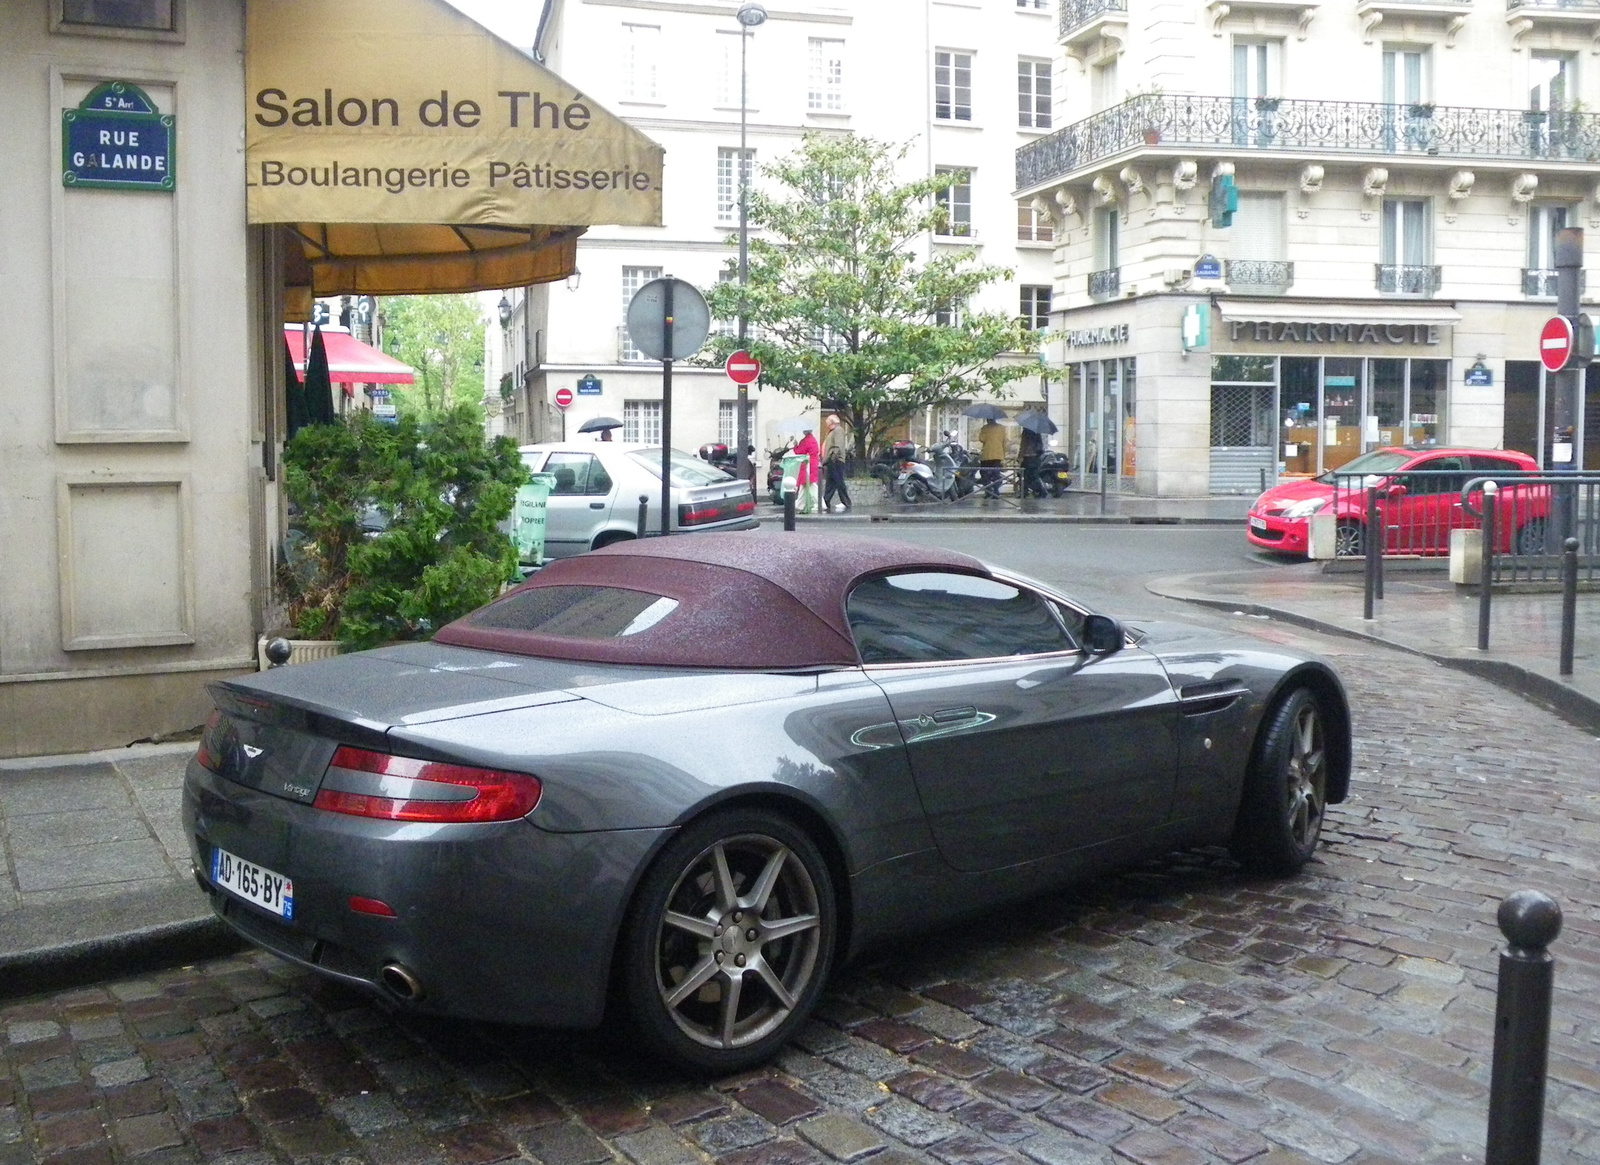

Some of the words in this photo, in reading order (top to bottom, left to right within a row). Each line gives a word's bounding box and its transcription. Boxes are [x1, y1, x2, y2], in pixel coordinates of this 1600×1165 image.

[255, 88, 399, 128] Salon
[419, 90, 481, 128] de
[498, 91, 591, 131] Thé
[99, 130, 139, 147] RUE
[73, 152, 165, 171] GALANDE
[261, 161, 470, 194] Boulangerie
[489, 161, 650, 191] Pâtisserie
[1231, 321, 1441, 344] PHARMACIE
